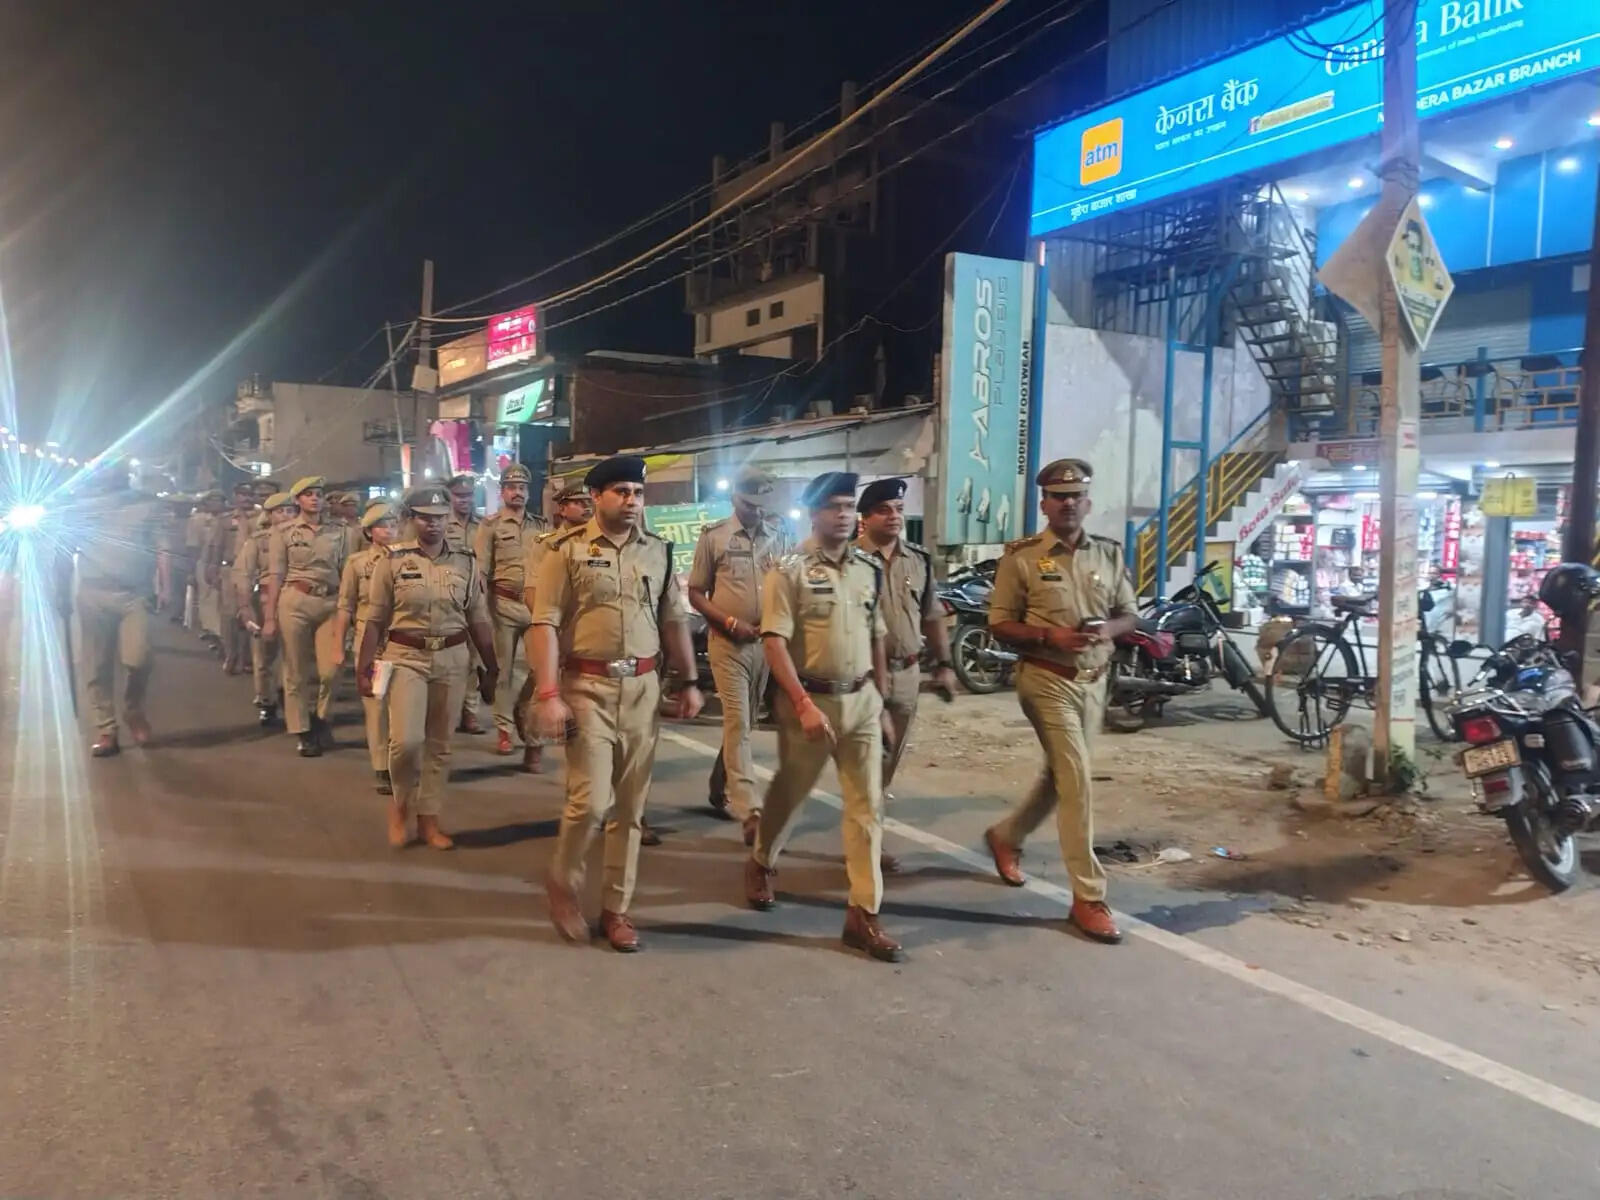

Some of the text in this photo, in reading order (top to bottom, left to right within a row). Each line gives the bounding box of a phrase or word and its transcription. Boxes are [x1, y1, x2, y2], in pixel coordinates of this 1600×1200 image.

[1325, 20, 1428, 76] Cana
[1452, 72, 1505, 100] BAZAR
[1509, 48, 1581, 83] BRANCH
[1155, 94, 1215, 136] केनरा
[1221, 78, 1259, 112] बैंक
[1085, 142, 1118, 166] atm
[1017, 340, 1030, 476] MODERN FOOTWEAR
